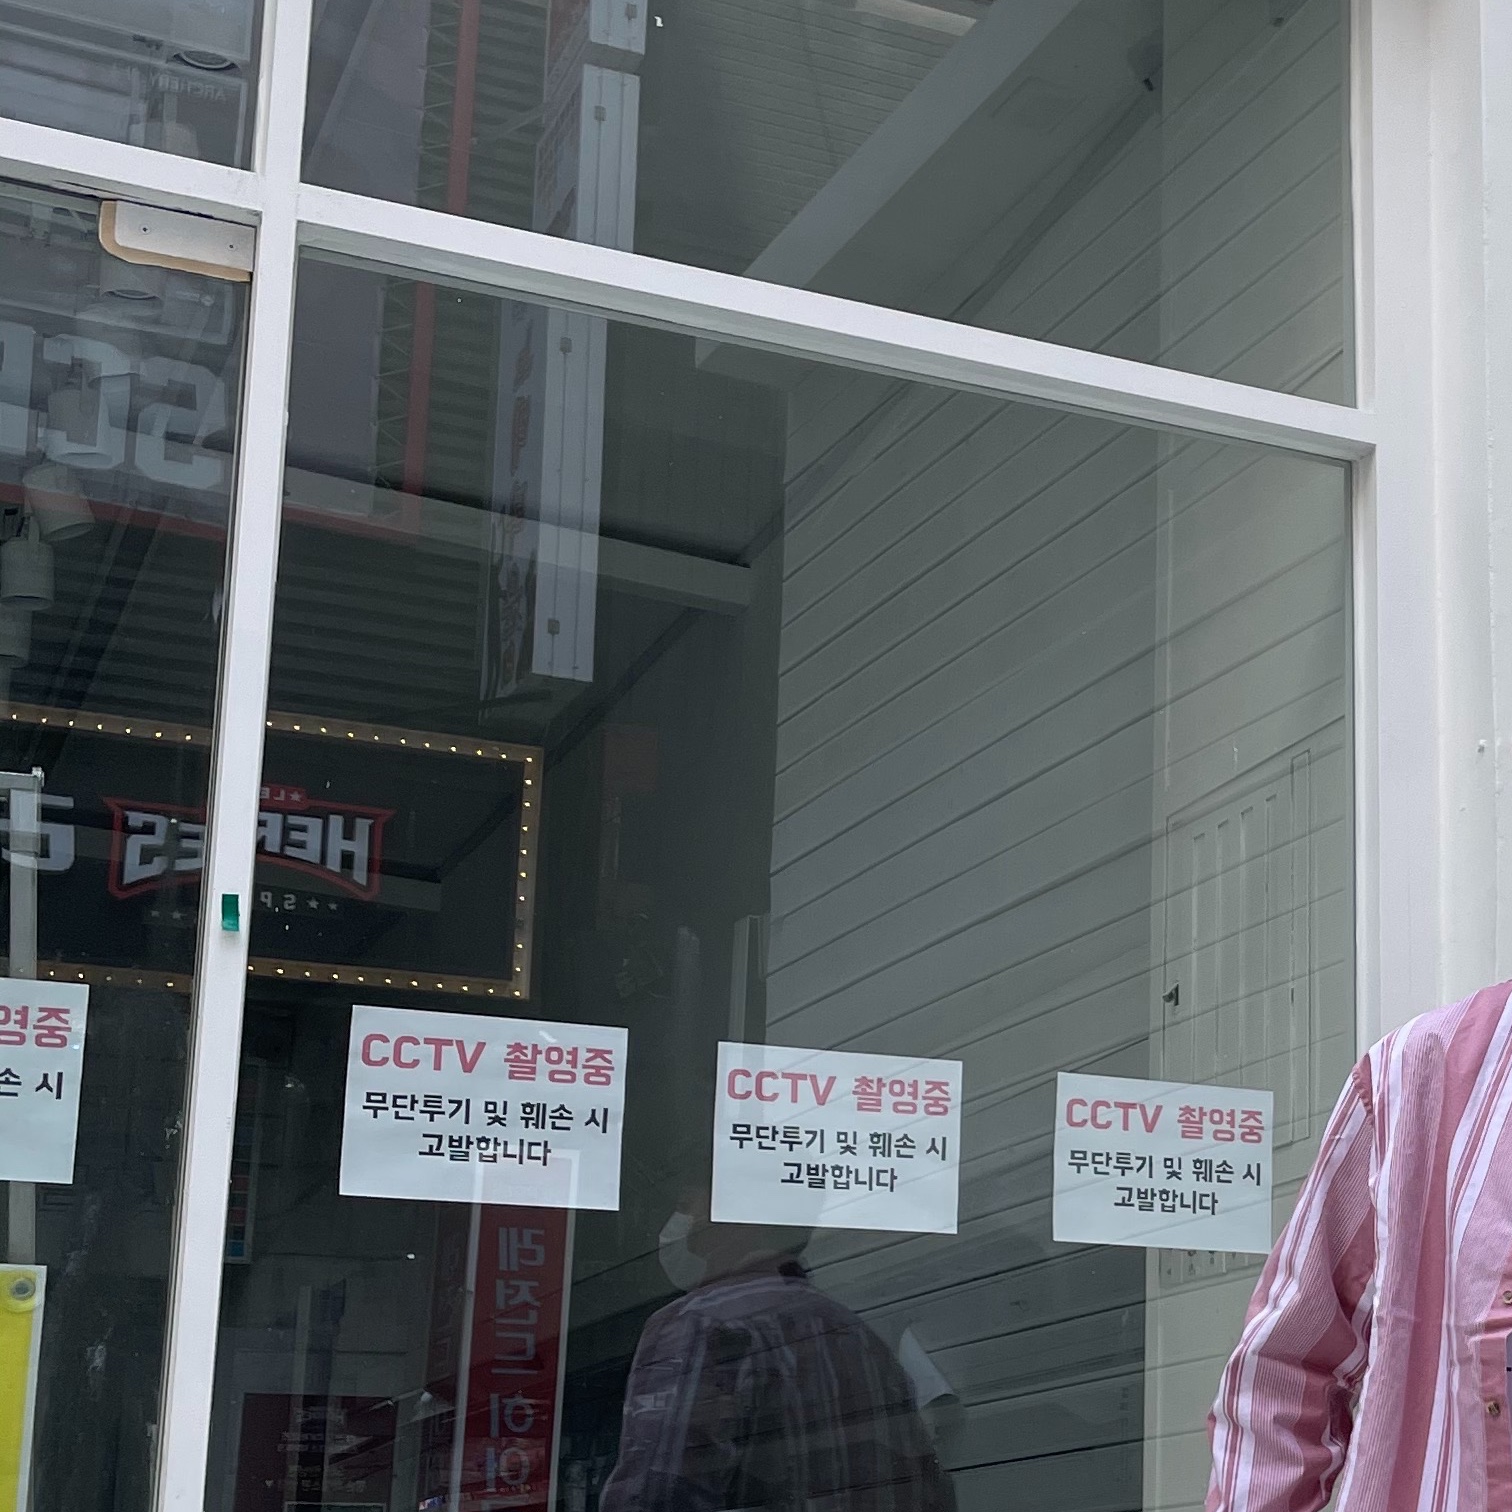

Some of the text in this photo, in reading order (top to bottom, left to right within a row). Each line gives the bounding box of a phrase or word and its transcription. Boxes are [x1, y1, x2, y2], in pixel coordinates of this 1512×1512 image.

[0, 1005, 72, 1048] 영중
[361, 1033, 615, 1087] CCTV 촬영중
[0, 1067, 64, 1100] 손 시
[726, 1068, 952, 1117] CCTV 촬영중
[362, 1091, 609, 1134] 무단투기 및 훼손 시
[1065, 1098, 1266, 1144] CCTV 촬영중
[418, 1133, 552, 1167] 고발합니다
[729, 1123, 948, 1161] 무단투기 및 훼손 시
[780, 1162, 899, 1193] 고발합니다
[1067, 1150, 1262, 1186] 무단투기 및 훼손 시
[1113, 1186, 1220, 1216] 고발합니다
